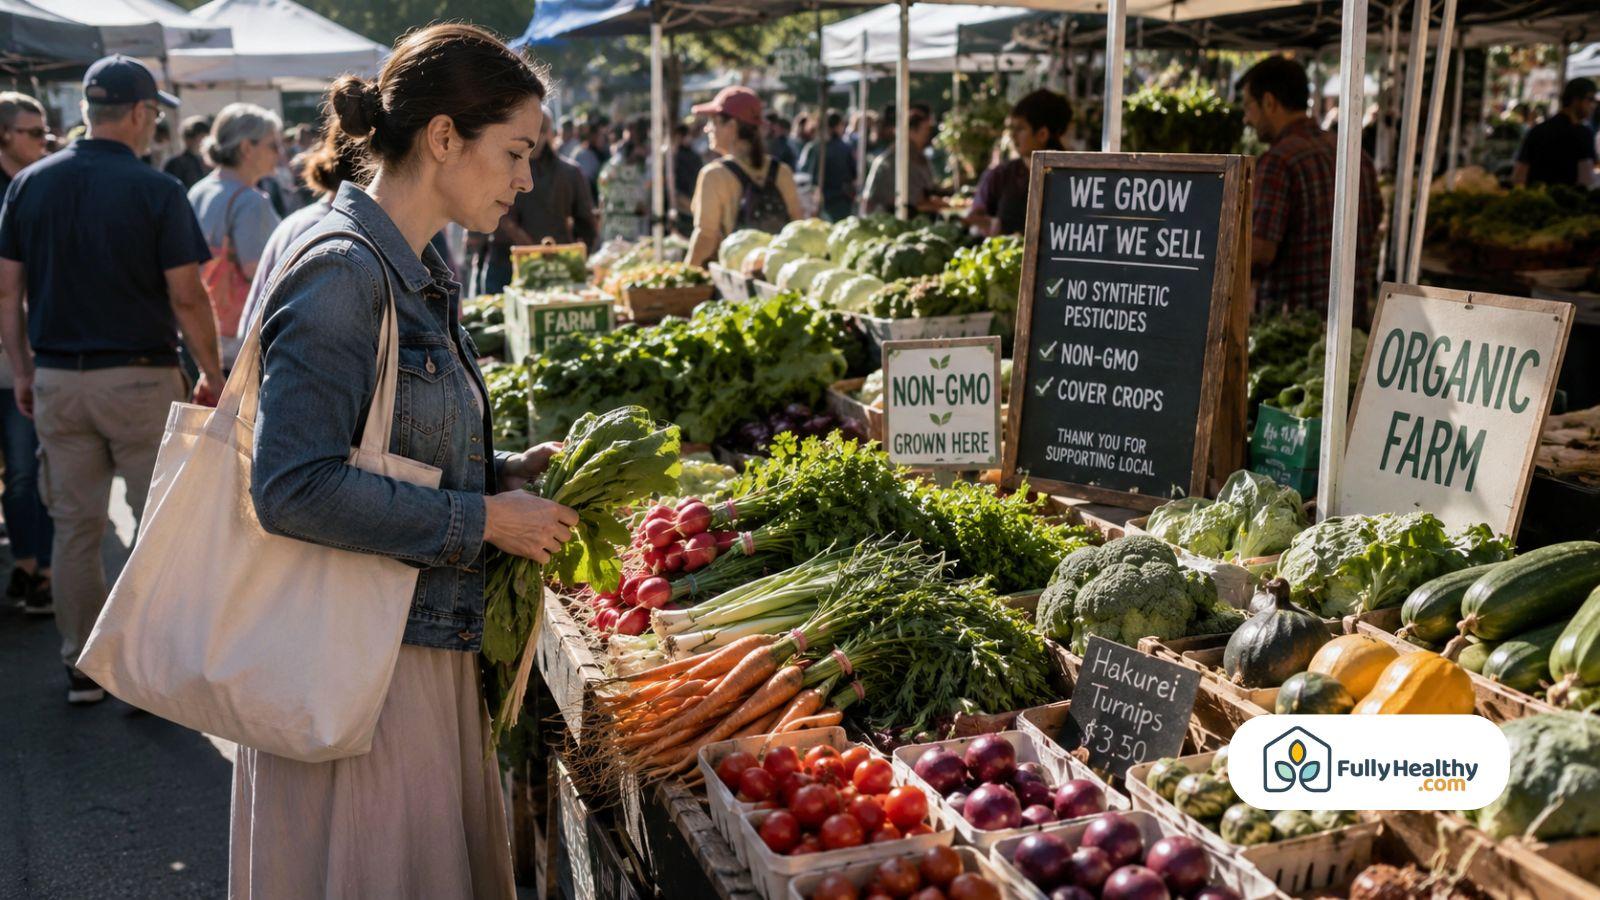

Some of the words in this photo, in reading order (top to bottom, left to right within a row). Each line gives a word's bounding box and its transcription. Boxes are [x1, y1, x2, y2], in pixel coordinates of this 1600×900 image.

[1070, 176, 1107, 209] WE
[1114, 177, 1193, 213] GROW
[1050, 222, 1109, 253] WHAT
[1116, 226, 1149, 256] WE
[1155, 228, 1205, 260] SELL
[1066, 279, 1088, 301] NO
[1092, 281, 1170, 307] SYNTHETIC
[544, 310, 597, 333] FARM
[1064, 305, 1148, 333] PESTICIDES
[1061, 343, 1139, 372] NON-GMO
[1376, 328, 1541, 414] ORGANIC
[893, 372, 991, 407] NON-GMO
[1057, 379, 1107, 405] COVER
[1112, 385, 1164, 412] CROPS
[893, 432, 946, 455] GROWN
[952, 432, 990, 454] HERE
[1057, 427, 1095, 448] THANK
[1098, 433, 1121, 451] YOU
[1124, 436, 1147, 455] FOR
[1379, 410, 1487, 493] FARM
[1045, 445, 1116, 471] SUPPORTING
[1118, 456, 1156, 477] LOCAL
[1091, 646, 1182, 702] Hakurei
[1091, 682, 1163, 735] Turnips
[1081, 718, 1148, 765] $3.50
